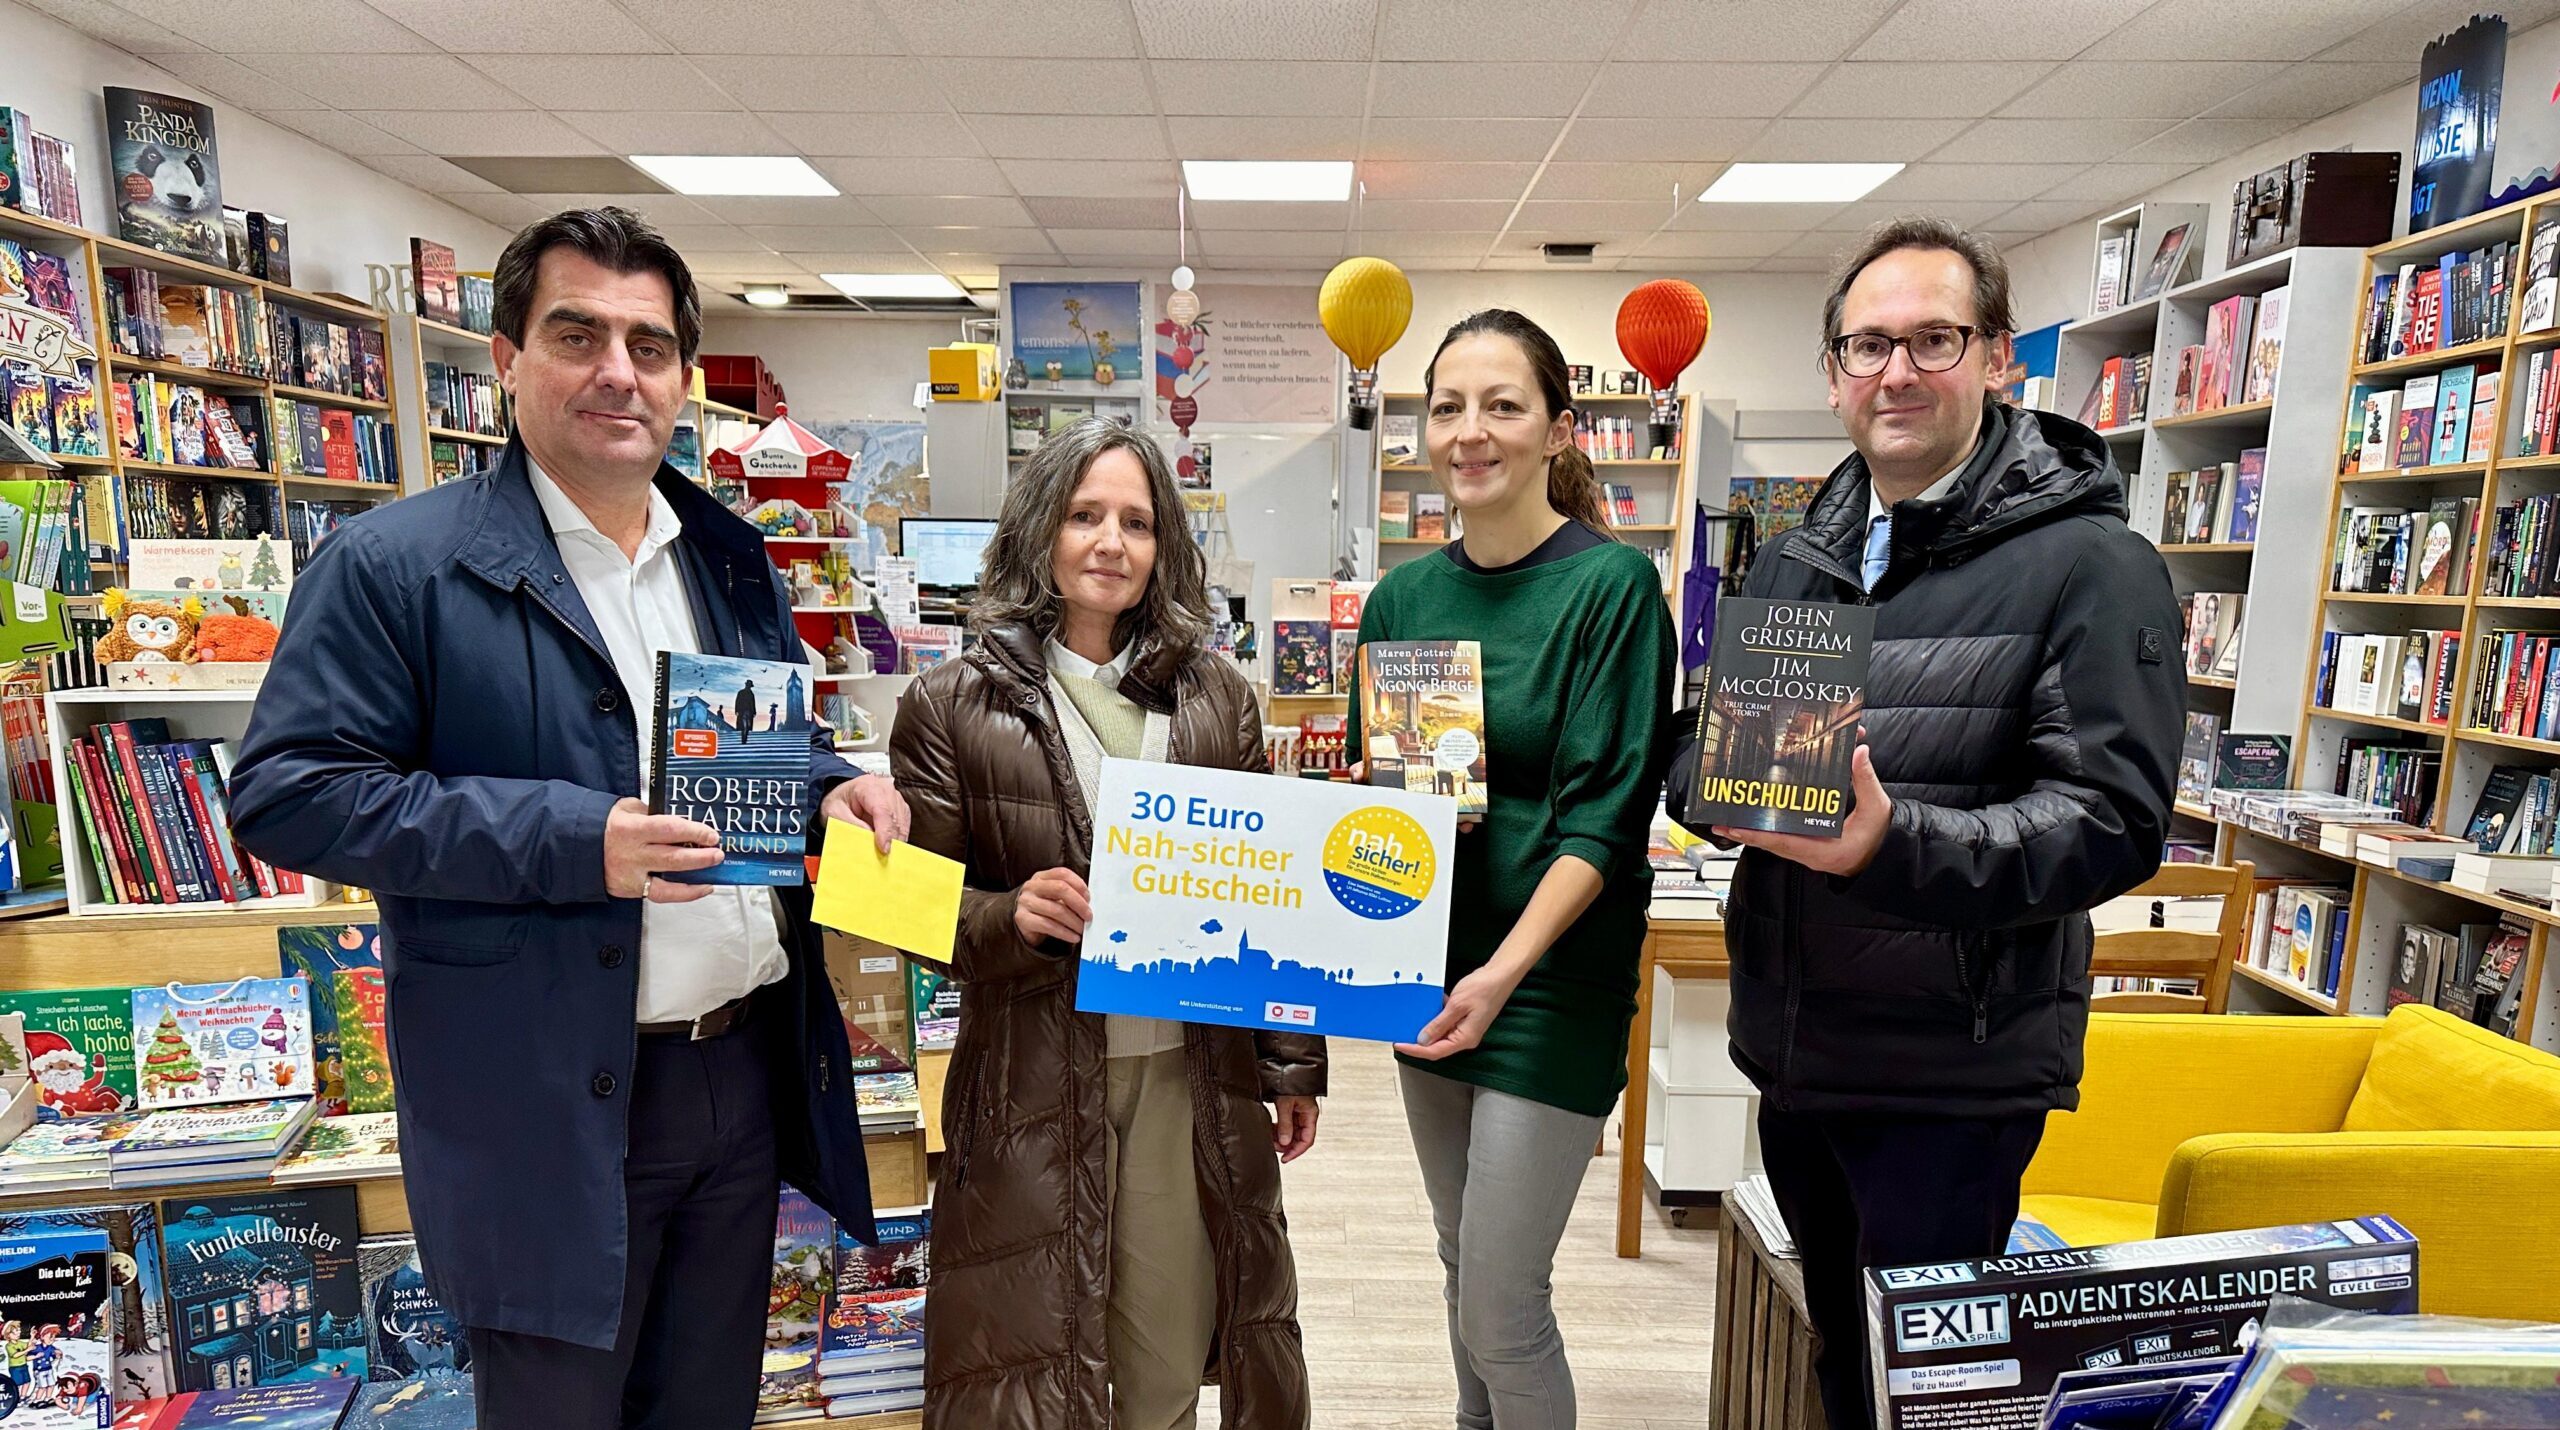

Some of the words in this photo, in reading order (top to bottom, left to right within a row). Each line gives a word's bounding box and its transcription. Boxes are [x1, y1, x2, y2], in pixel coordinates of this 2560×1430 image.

[2421, 69, 2462, 112] WENN
[138, 104, 198, 135] PANDA
[124, 121, 210, 155] KINGDOM
[2434, 123, 2463, 159] SIE
[2418, 292, 2440, 318] TIE
[2413, 317, 2437, 345] RE
[1021, 336, 1070, 348] emons:
[1222, 348, 1267, 356] Antworten
[1269, 361, 1280, 369] sie
[332, 455, 349, 466] THE
[762, 450, 784, 460] Bunte
[750, 458, 797, 469] Geschenke
[332, 468, 350, 478] FIRE
[21, 601, 41, 610] Vor-
[1764, 605, 1834, 628] JOHN
[1740, 627, 1852, 652] GRISHAM
[1378, 649, 1412, 658] Maren
[1414, 648, 1472, 658] Gottschalk
[1377, 662, 1440, 677] JENSEITS
[1444, 664, 1471, 676] DER
[1770, 657, 1811, 678] JIM
[1375, 679, 1426, 693] NGONG
[1430, 677, 1475, 693] BERGE
[2432, 681, 2444, 719] KEANU
[2439, 636, 2450, 677] REEVES
[1695, 665, 1711, 739] UNSCHULDIG
[1723, 700, 1744, 709] TRUE
[1745, 702, 1771, 711] CRIME
[1732, 708, 1761, 718] STORYS
[2234, 748, 2260, 757] ESCAPE
[2261, 748, 2280, 757] PARK
[670, 774, 805, 807] ROBERT
[1703, 776, 1841, 815] UNSCHULDIG
[1130, 791, 1176, 822] 30
[1186, 796, 1265, 833] Euro
[2524, 785, 2537, 830] SPURLOS
[1804, 818, 1831, 827] HEYNE
[1107, 824, 1294, 873] Nah-sicher
[1347, 828, 1403, 860] nah
[1352, 844, 1420, 878] sicher!
[768, 868, 793, 877] HEYNE
[1131, 863, 1303, 910] Gutschein
[36, 1006, 65, 1015] Streicheln
[67, 1005, 79, 1013] und
[176, 1006, 202, 1019] Meine
[858, 1001, 866, 1010] 11
[1190, 1002, 1231, 1012] Unterstützung
[57, 1016, 77, 1032] Ich
[83, 1015, 127, 1033] lache,
[199, 1016, 255, 1028] Weihnachten
[185, 1217, 342, 1265] Funkelfenster
[1889, 1264, 1967, 1283] EXIT
[1980, 1234, 2266, 1274] ADVENTSKALENDER
[38, 1268, 54, 1280] Die
[55, 1266, 73, 1279] drei
[75, 1277, 92, 1287] Kids
[2332, 1282, 2371, 1294] LEVEL
[393, 1288, 412, 1300] DIE
[1900, 1301, 2002, 1342] EXIT
[2018, 1265, 2318, 1320] ADVENTSKALENDER
[2033, 1320, 2050, 1330] Das
[2050, 1313, 2122, 1329] intergalaktische
[2123, 1308, 2176, 1321] Wettrennen
[2184, 1306, 2199, 1315] mit
[2201, 1304, 2213, 1313] 24
[2214, 1300, 2267, 1313] spannenden
[1932, 1336, 1955, 1346] DAS
[1968, 1331, 2005, 1342] SPIEL
[2137, 1336, 2168, 1351] EXIT
[2088, 1351, 2120, 1367] EXIT
[2138, 1344, 2221, 1365] ADVENTSKALENDER
[1911, 1370, 1926, 1379] Das
[1928, 1363, 2004, 1377] Escape-Room-Spiel
[1912, 1383, 1925, 1391] für
[1939, 1379, 1966, 1389] Hause!
[236, 1392, 258, 1401] Am
[263, 1386, 317, 1398] Himmel
[100, 1398, 108, 1425] KOSMOS
[1914, 1404, 1940, 1412] Monaten
[1941, 1402, 1958, 1410] kennt
[1970, 1401, 1988, 1409] ganze
[1989, 1397, 2011, 1405] Kosmos
[1914, 1413, 1931, 1421] große
